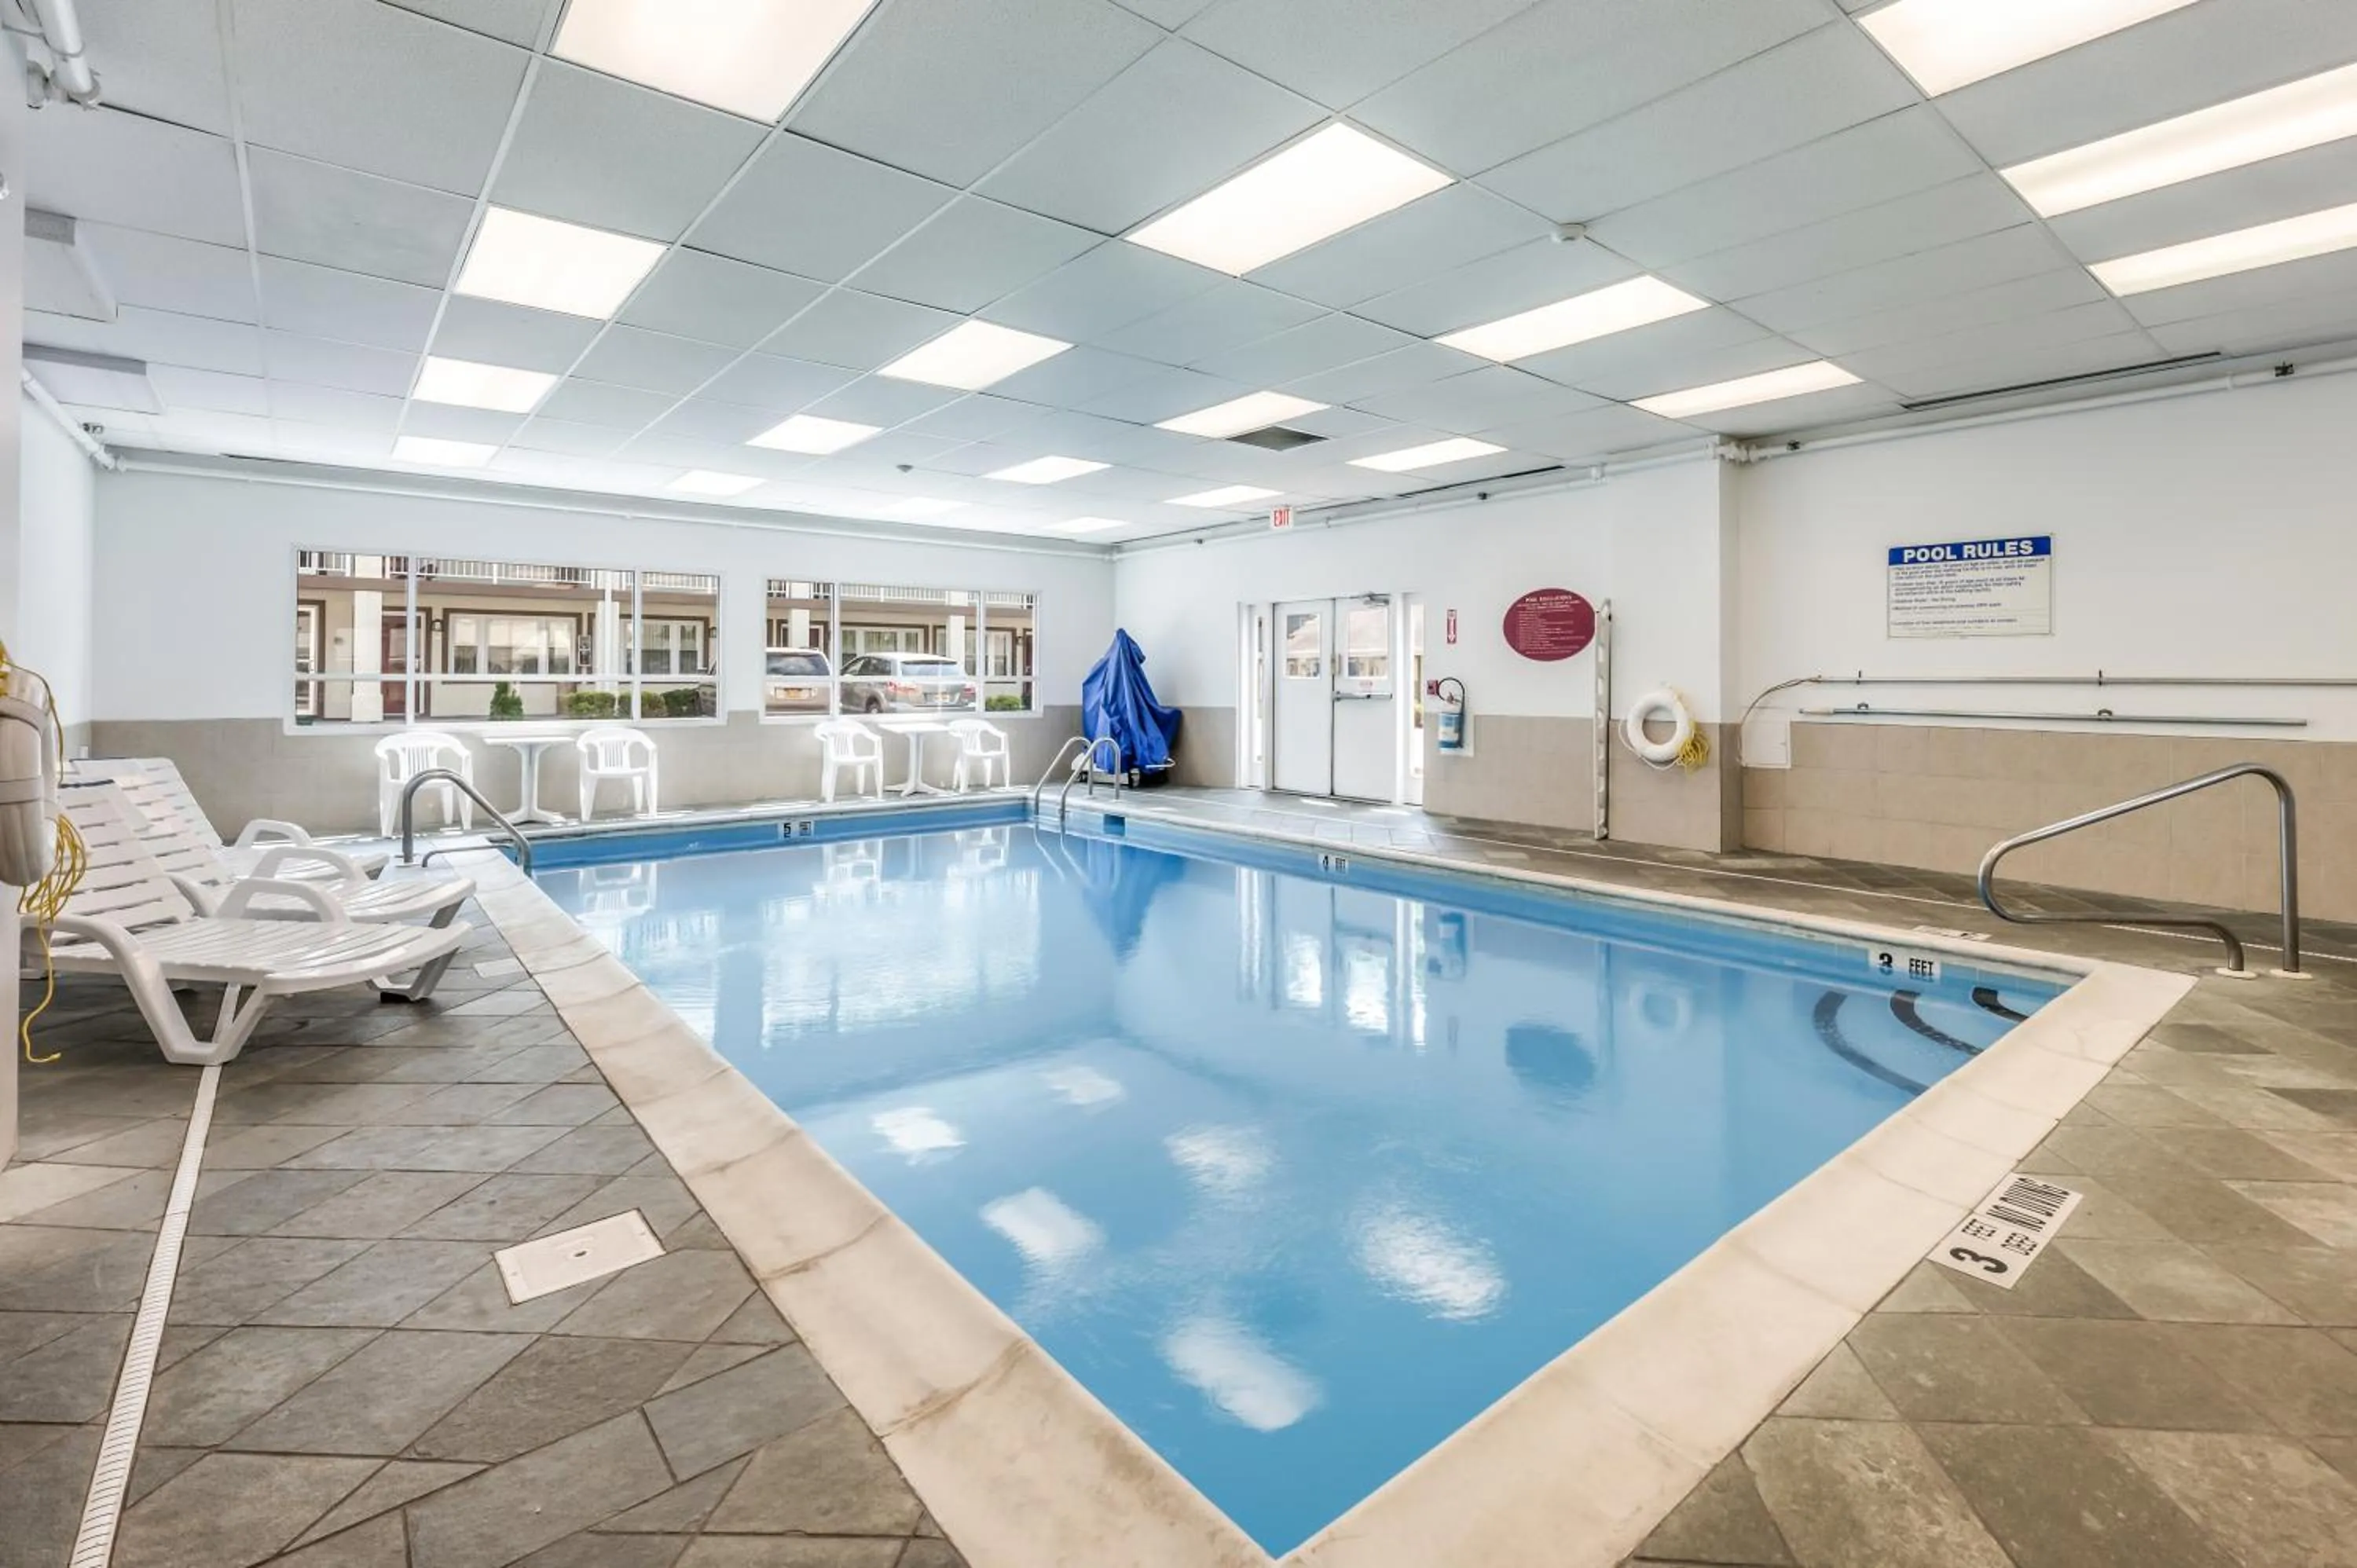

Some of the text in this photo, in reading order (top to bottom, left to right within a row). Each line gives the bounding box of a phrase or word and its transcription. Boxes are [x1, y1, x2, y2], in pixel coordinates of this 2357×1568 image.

[1274, 508, 1290, 527] EXIT
[1903, 540, 2034, 563] POOL RULES
[1985, 1177, 2070, 1232] NO DIVING
[1949, 1246, 2009, 1273] 3
